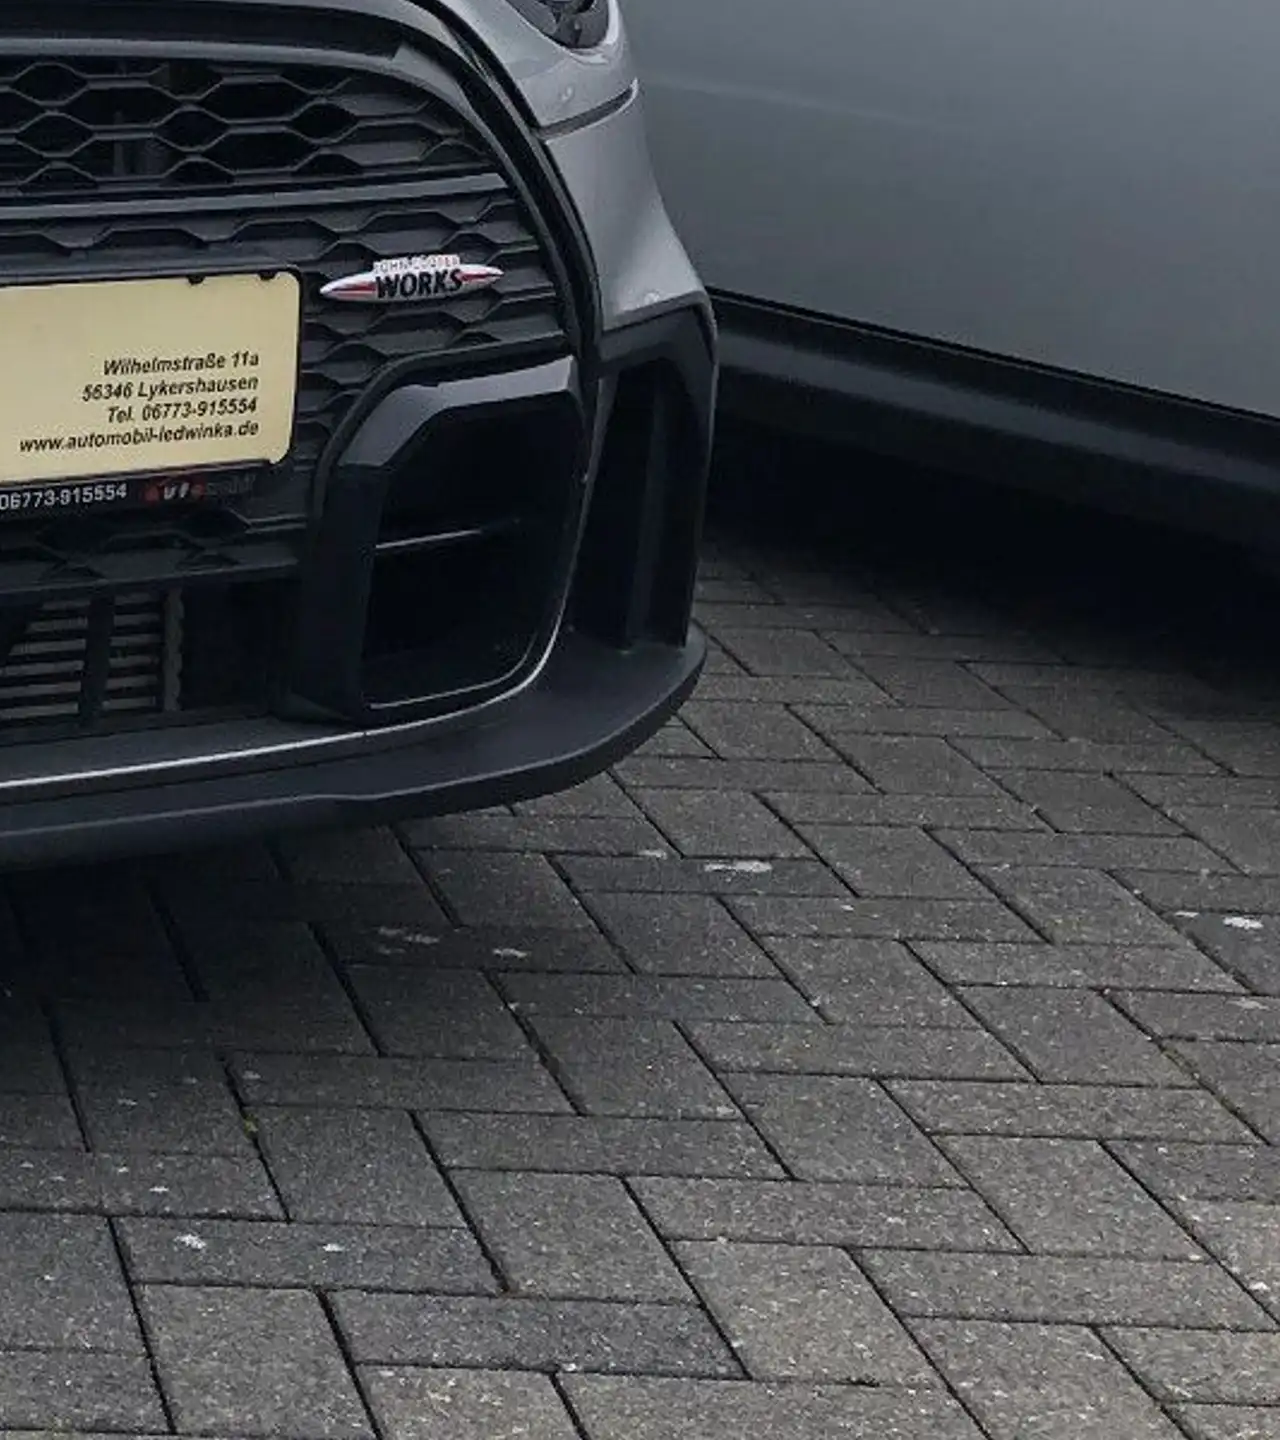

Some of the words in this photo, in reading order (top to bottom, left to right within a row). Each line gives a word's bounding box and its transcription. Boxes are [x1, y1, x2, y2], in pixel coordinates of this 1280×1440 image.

[375, 268, 463, 298] WORKS
[103, 353, 226, 376] Wilhelmstraße
[231, 351, 259, 368] 11a
[82, 382, 133, 402] 56346
[138, 375, 259, 401] Lykershausen
[142, 396, 258, 421] 06773-915554
[19, 420, 260, 452] www.automobil-ledwinka.de
